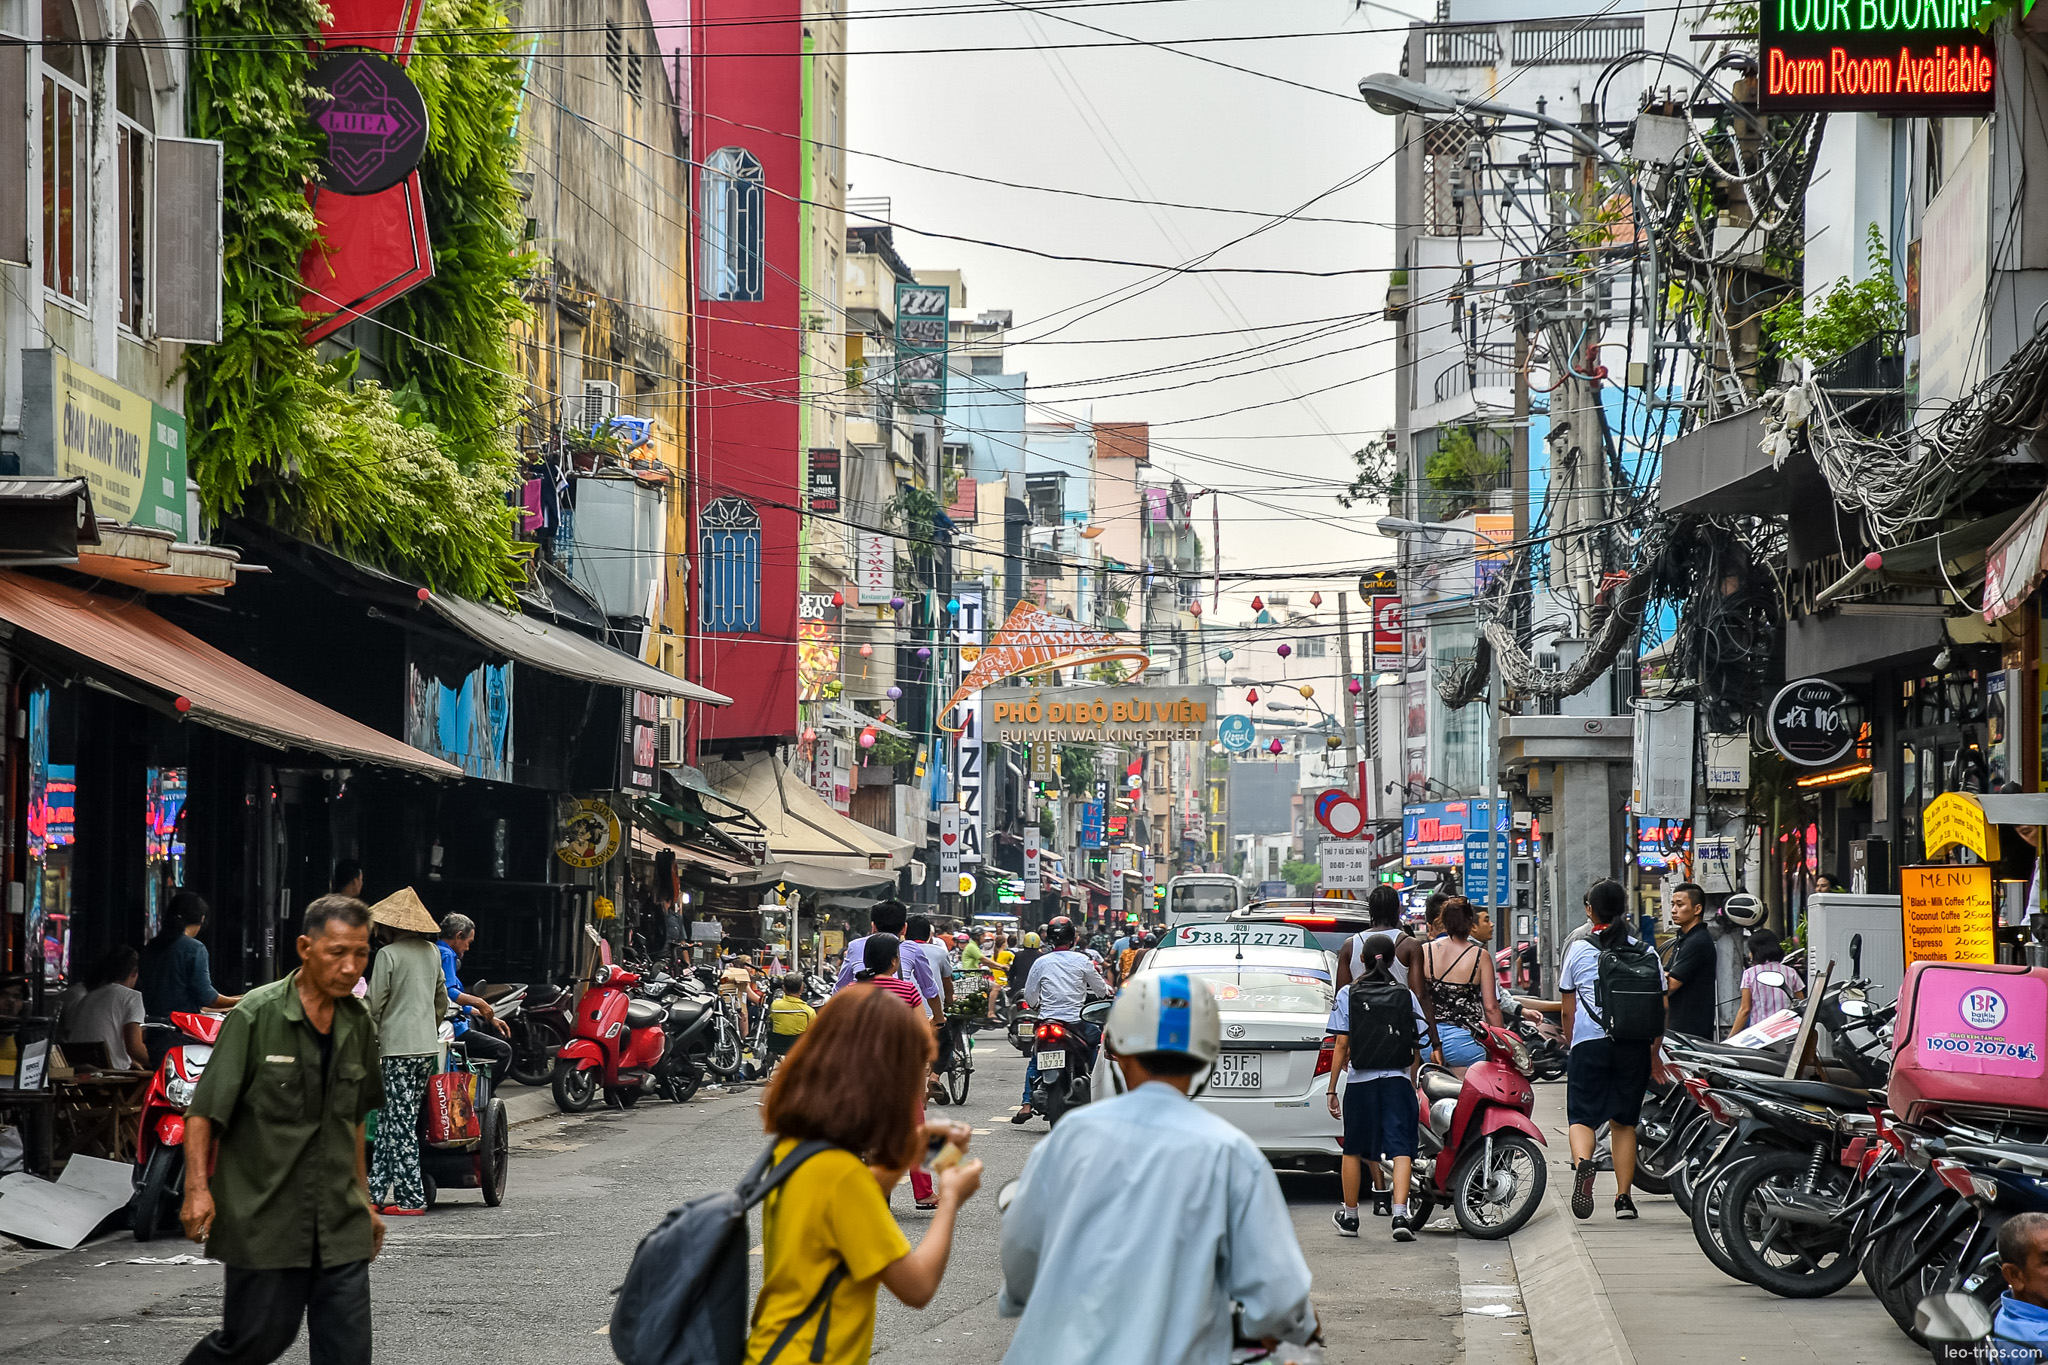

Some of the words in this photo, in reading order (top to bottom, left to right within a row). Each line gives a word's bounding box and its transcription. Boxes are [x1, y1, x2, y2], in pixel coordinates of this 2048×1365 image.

[1776, 0, 1850, 31] TOUR
[1769, 46, 1825, 95] Dorm
[1831, 46, 1892, 94] Room
[1895, 45, 1992, 94] Available
[329, 113, 388, 132] LUCA
[88, 413, 113, 467] GIANG
[115, 426, 141, 479] TRAVEL
[816, 474, 833, 485] FULL
[1798, 686, 1831, 701] Quán
[994, 691, 1042, 723] PHỐ
[1047, 702, 1073, 723] ĐI
[1075, 698, 1108, 729] BỘ
[1112, 697, 1151, 723] BÙI
[1155, 697, 1207, 728] VIỆN
[1000, 730, 1028, 742] BUI
[1032, 730, 1067, 742] VIEN
[1070, 729, 1143, 742] WALKING
[1146, 728, 1202, 741] STREET
[1085, 805, 1099, 842] KIM
[590, 840, 617, 866] BOWLS
[1920, 872, 1972, 888] MENU
[1910, 897, 1927, 906] Black
[1931, 896, 1943, 906] Milk
[1944, 896, 1965, 906] Coffee
[1911, 911, 1939, 921] Coconut
[1941, 910, 1960, 920] Coffee
[1963, 909, 1992, 920] 25000
[1911, 924, 1943, 936] Cappucino
[1946, 924, 1961, 933] Latte
[1963, 924, 1992, 933] 25000
[1201, 932, 1249, 944] 38.27
[1254, 933, 1274, 945] 27
[1278, 933, 1298, 945] 27
[1912, 938, 1943, 949] Espresso
[1913, 951, 1948, 961] Smoothies
[1954, 950, 1989, 960] 25000
[1970, 994, 1998, 1012] BR
[1971, 1011, 1996, 1019] baskin
[1926, 1037, 1970, 1052] 1900
[1974, 1040, 2017, 1056] 2076
[1223, 1055, 1250, 1071] 51F
[1212, 1072, 1260, 1087] 317.88
